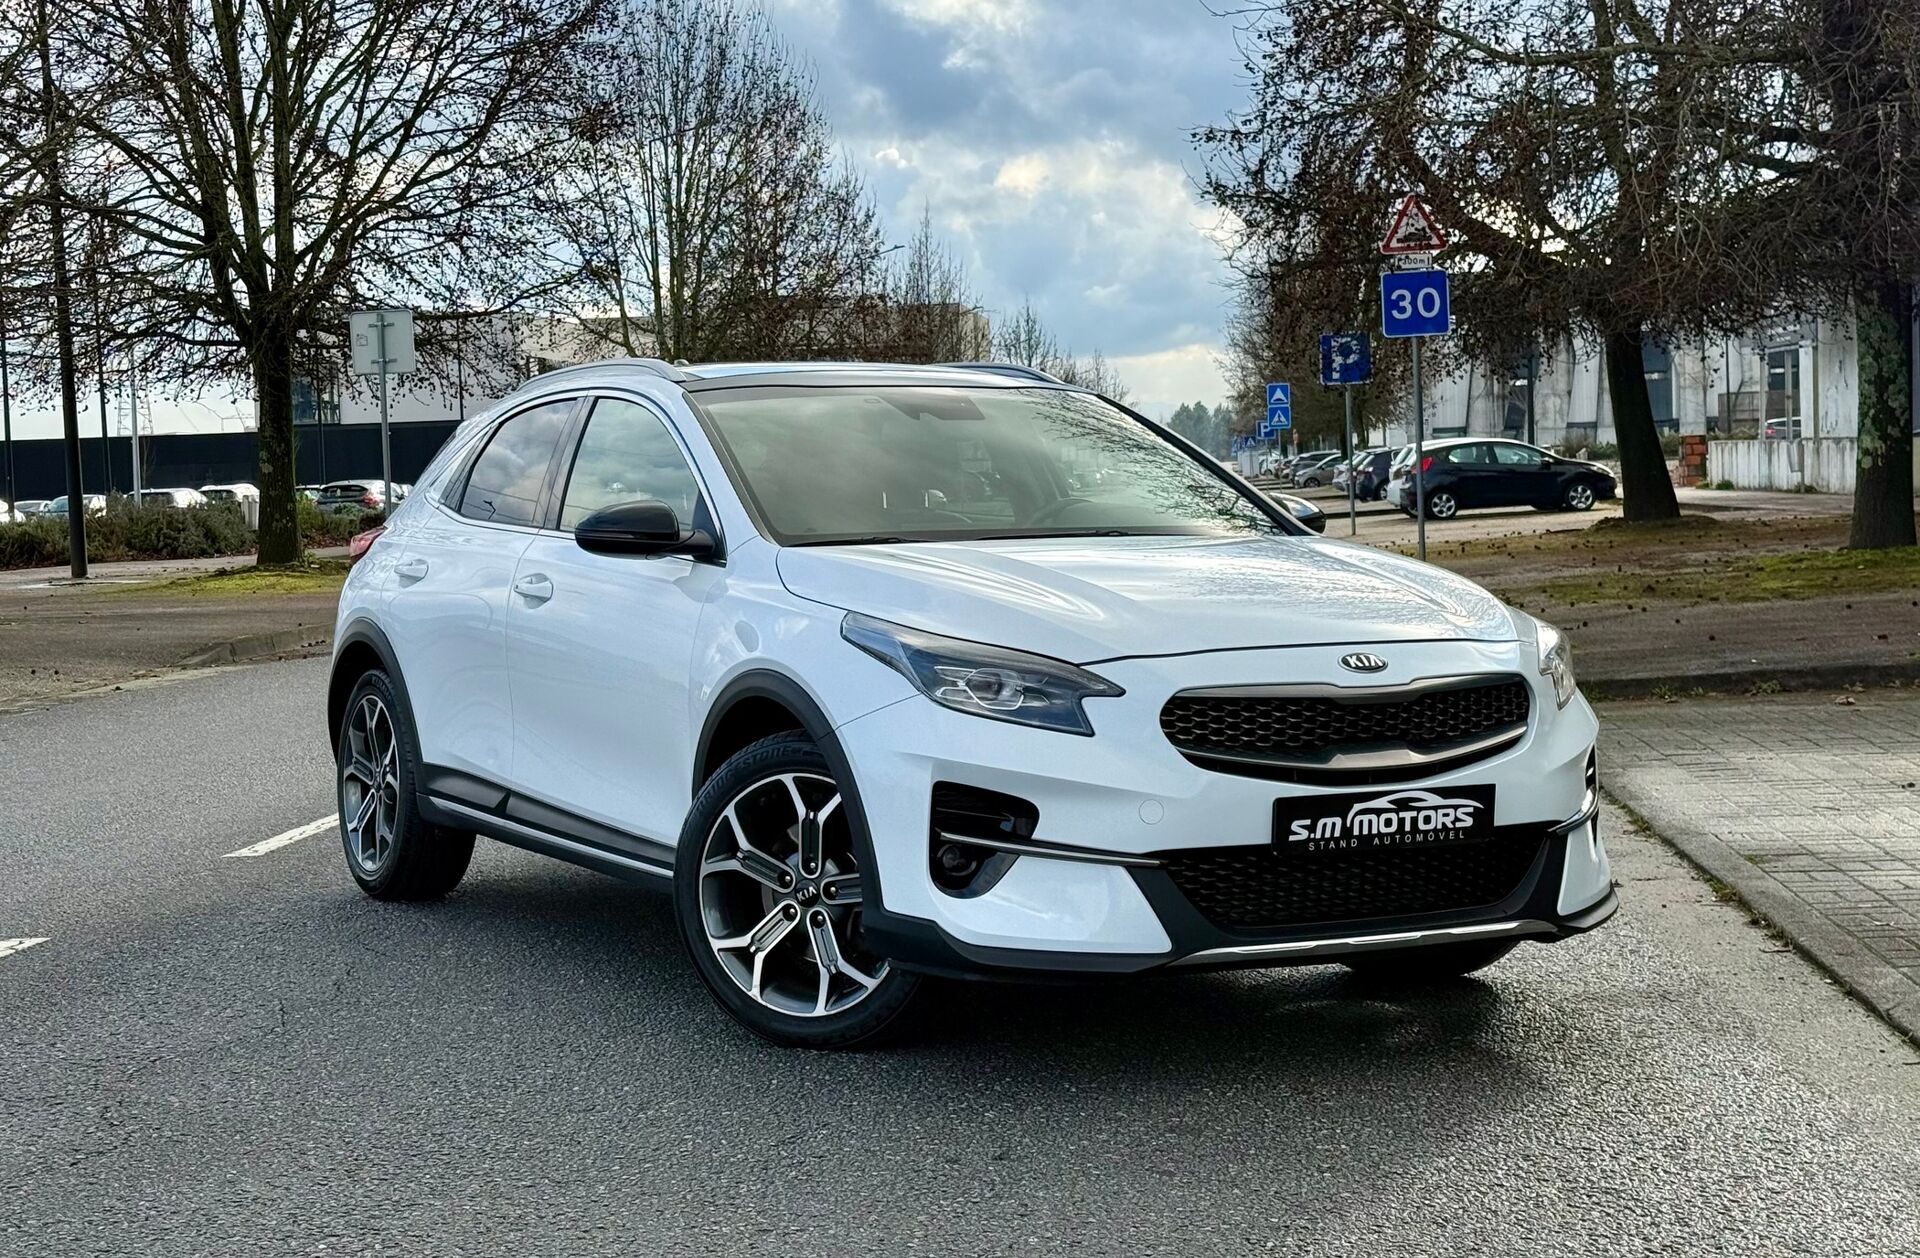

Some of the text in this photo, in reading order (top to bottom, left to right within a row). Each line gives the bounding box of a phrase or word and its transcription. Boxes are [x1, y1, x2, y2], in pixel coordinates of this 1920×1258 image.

[1390, 287, 1440, 319] 30
[1331, 337, 1360, 379] P
[1260, 422, 1271, 438] P
[1345, 654, 1383, 667] KIA
[1288, 807, 1474, 841] S.M MOTORS
[1308, 830, 1465, 851] STAND AUTOMÓVEL
[796, 886, 817, 901] KIA
